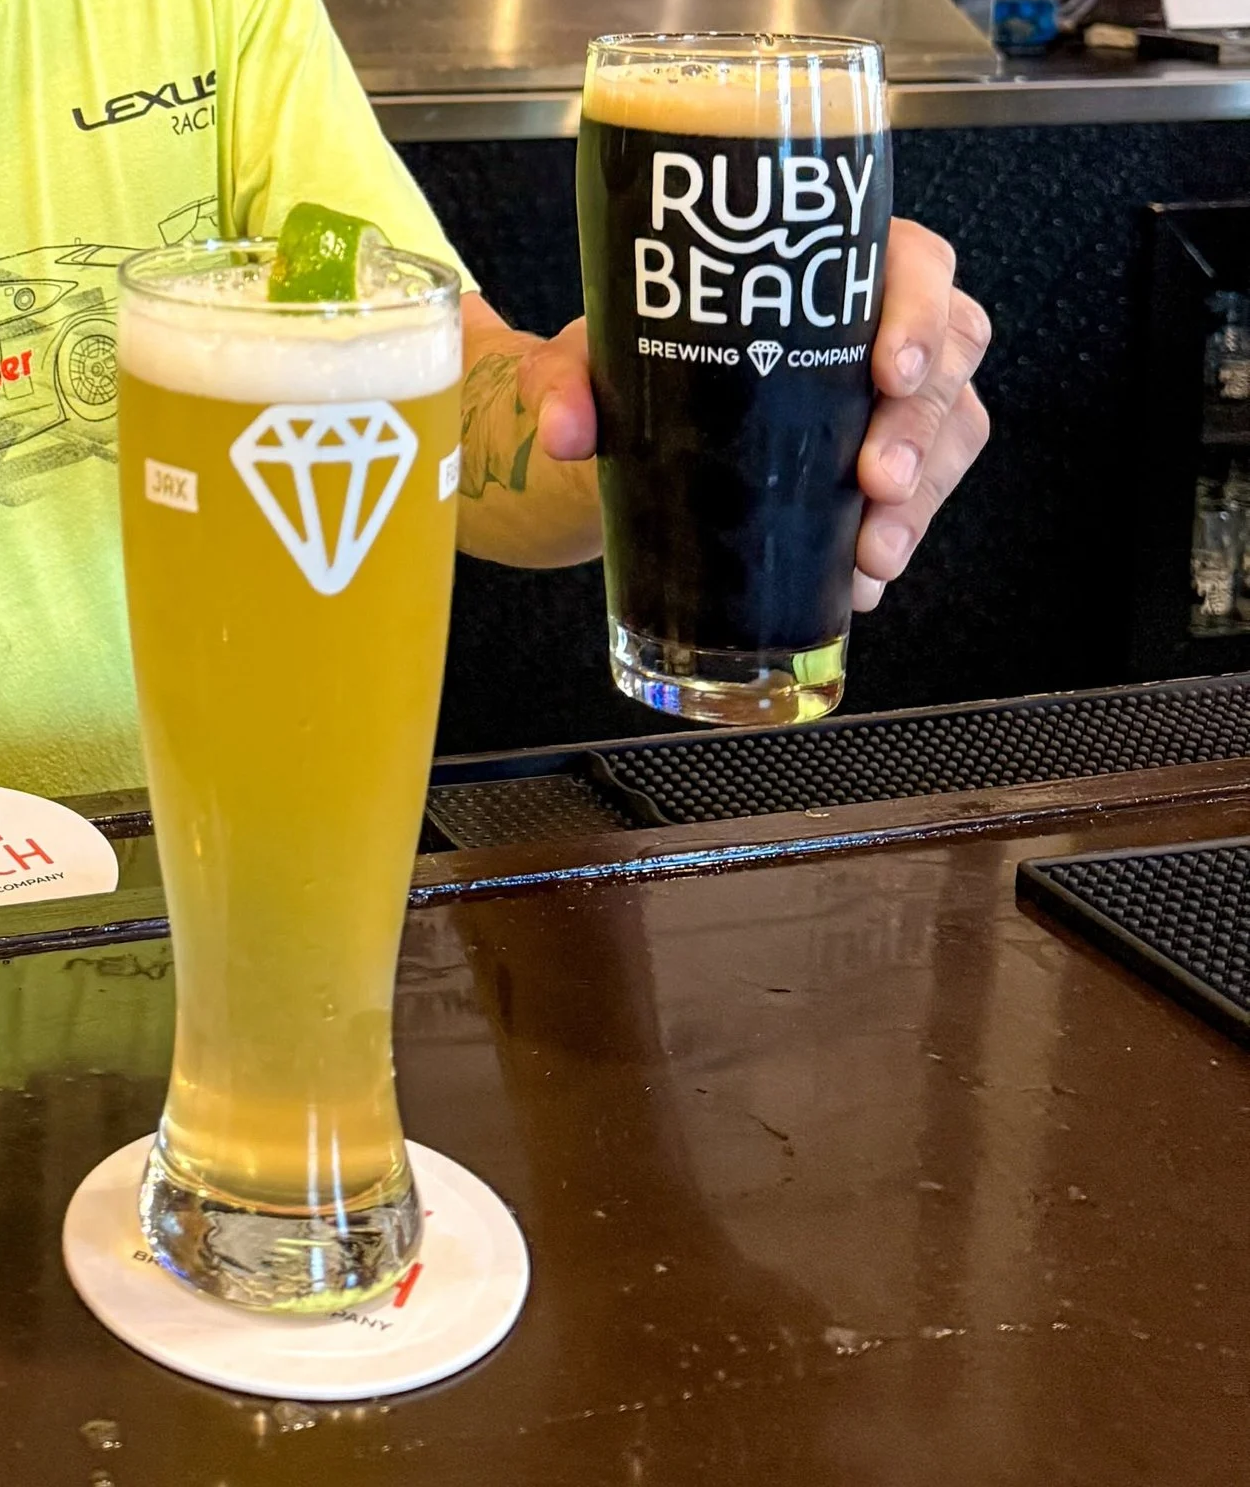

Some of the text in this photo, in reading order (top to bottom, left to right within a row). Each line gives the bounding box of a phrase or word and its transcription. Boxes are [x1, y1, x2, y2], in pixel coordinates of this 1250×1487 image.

[652, 152, 873, 258] RUBY
[635, 238, 877, 327] BEACH
[638, 337, 867, 368] BREWING COMPANY
[152, 470, 189, 502] JAX
